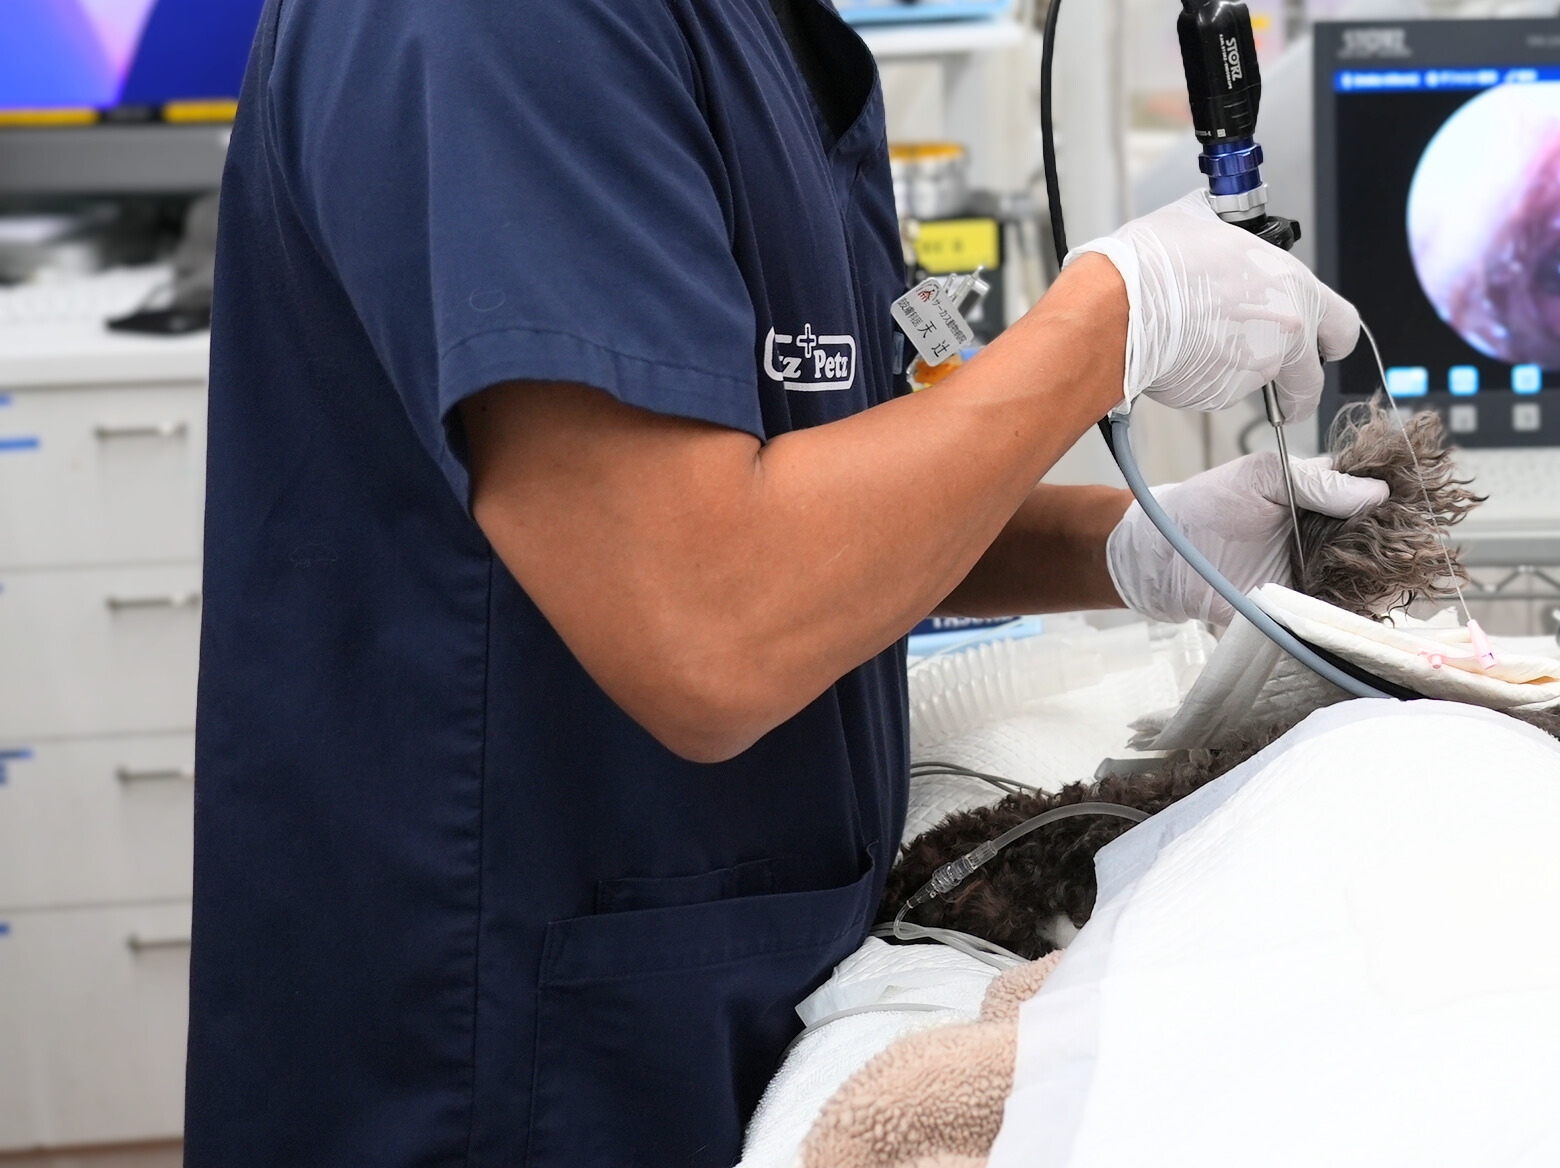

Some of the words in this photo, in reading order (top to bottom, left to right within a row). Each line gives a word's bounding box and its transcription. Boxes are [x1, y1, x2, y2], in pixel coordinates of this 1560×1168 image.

[1226, 37, 1242, 81] STORZ
[932, 299, 967, 344] サーカス動物病院
[813, 349, 848, 378] Petz
